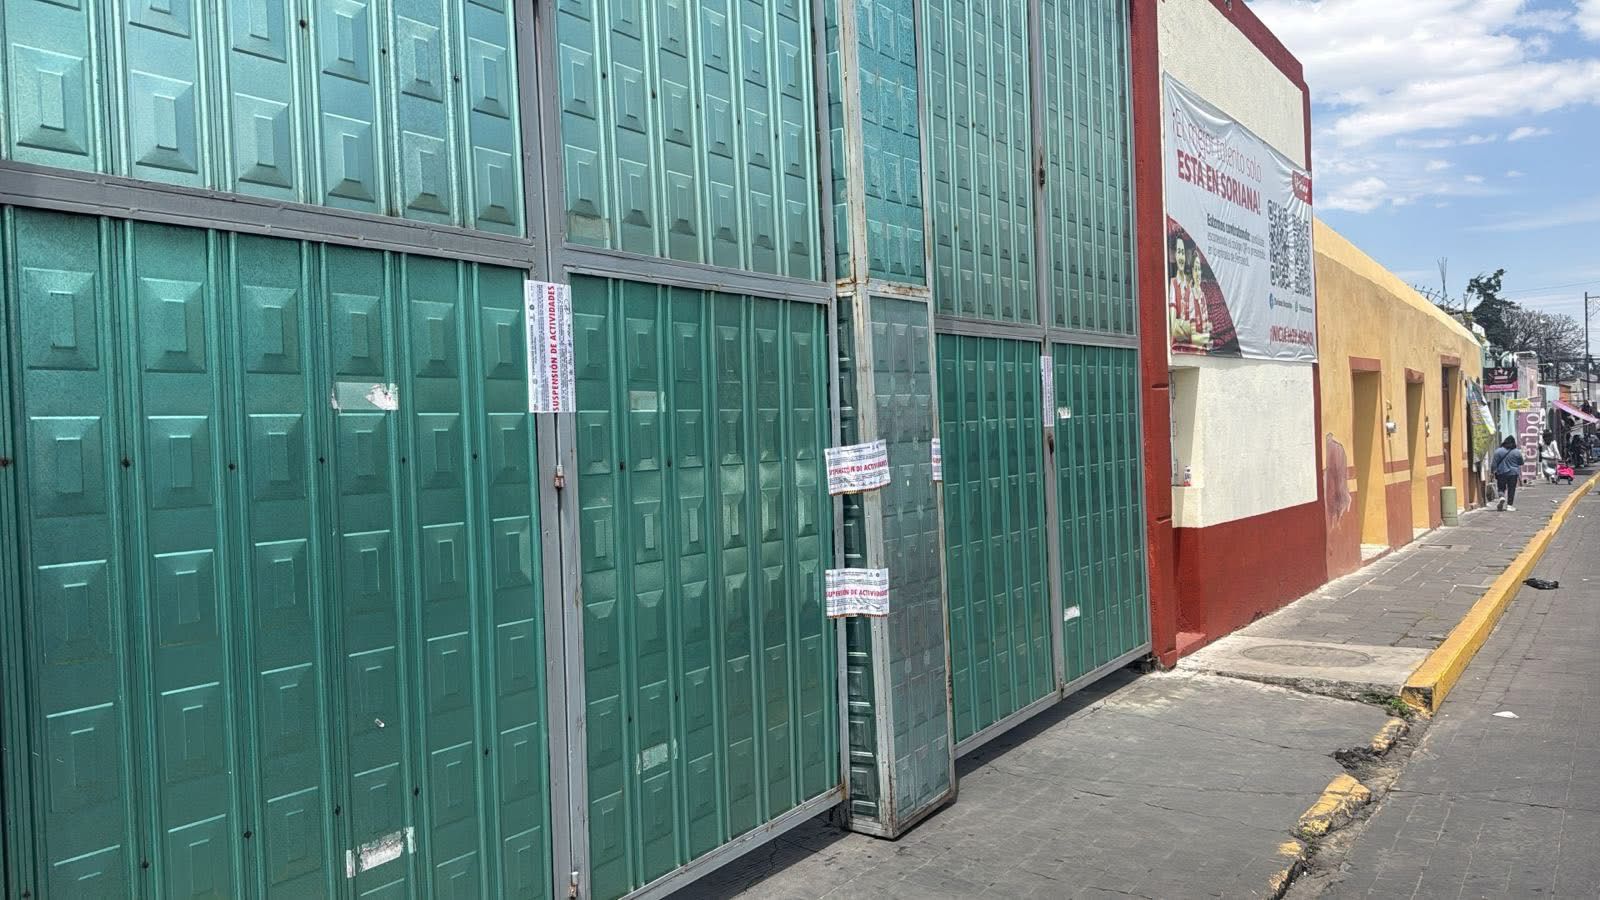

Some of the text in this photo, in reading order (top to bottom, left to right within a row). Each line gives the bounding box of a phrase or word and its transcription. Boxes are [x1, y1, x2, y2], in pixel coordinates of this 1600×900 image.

[1177, 148, 1205, 189] ESTÁ
[1205, 163, 1219, 195] EN
[1220, 172, 1261, 216] SORIANA!
[547, 285, 559, 412] SUSPENSIÓN DE ACTIVIDADES
